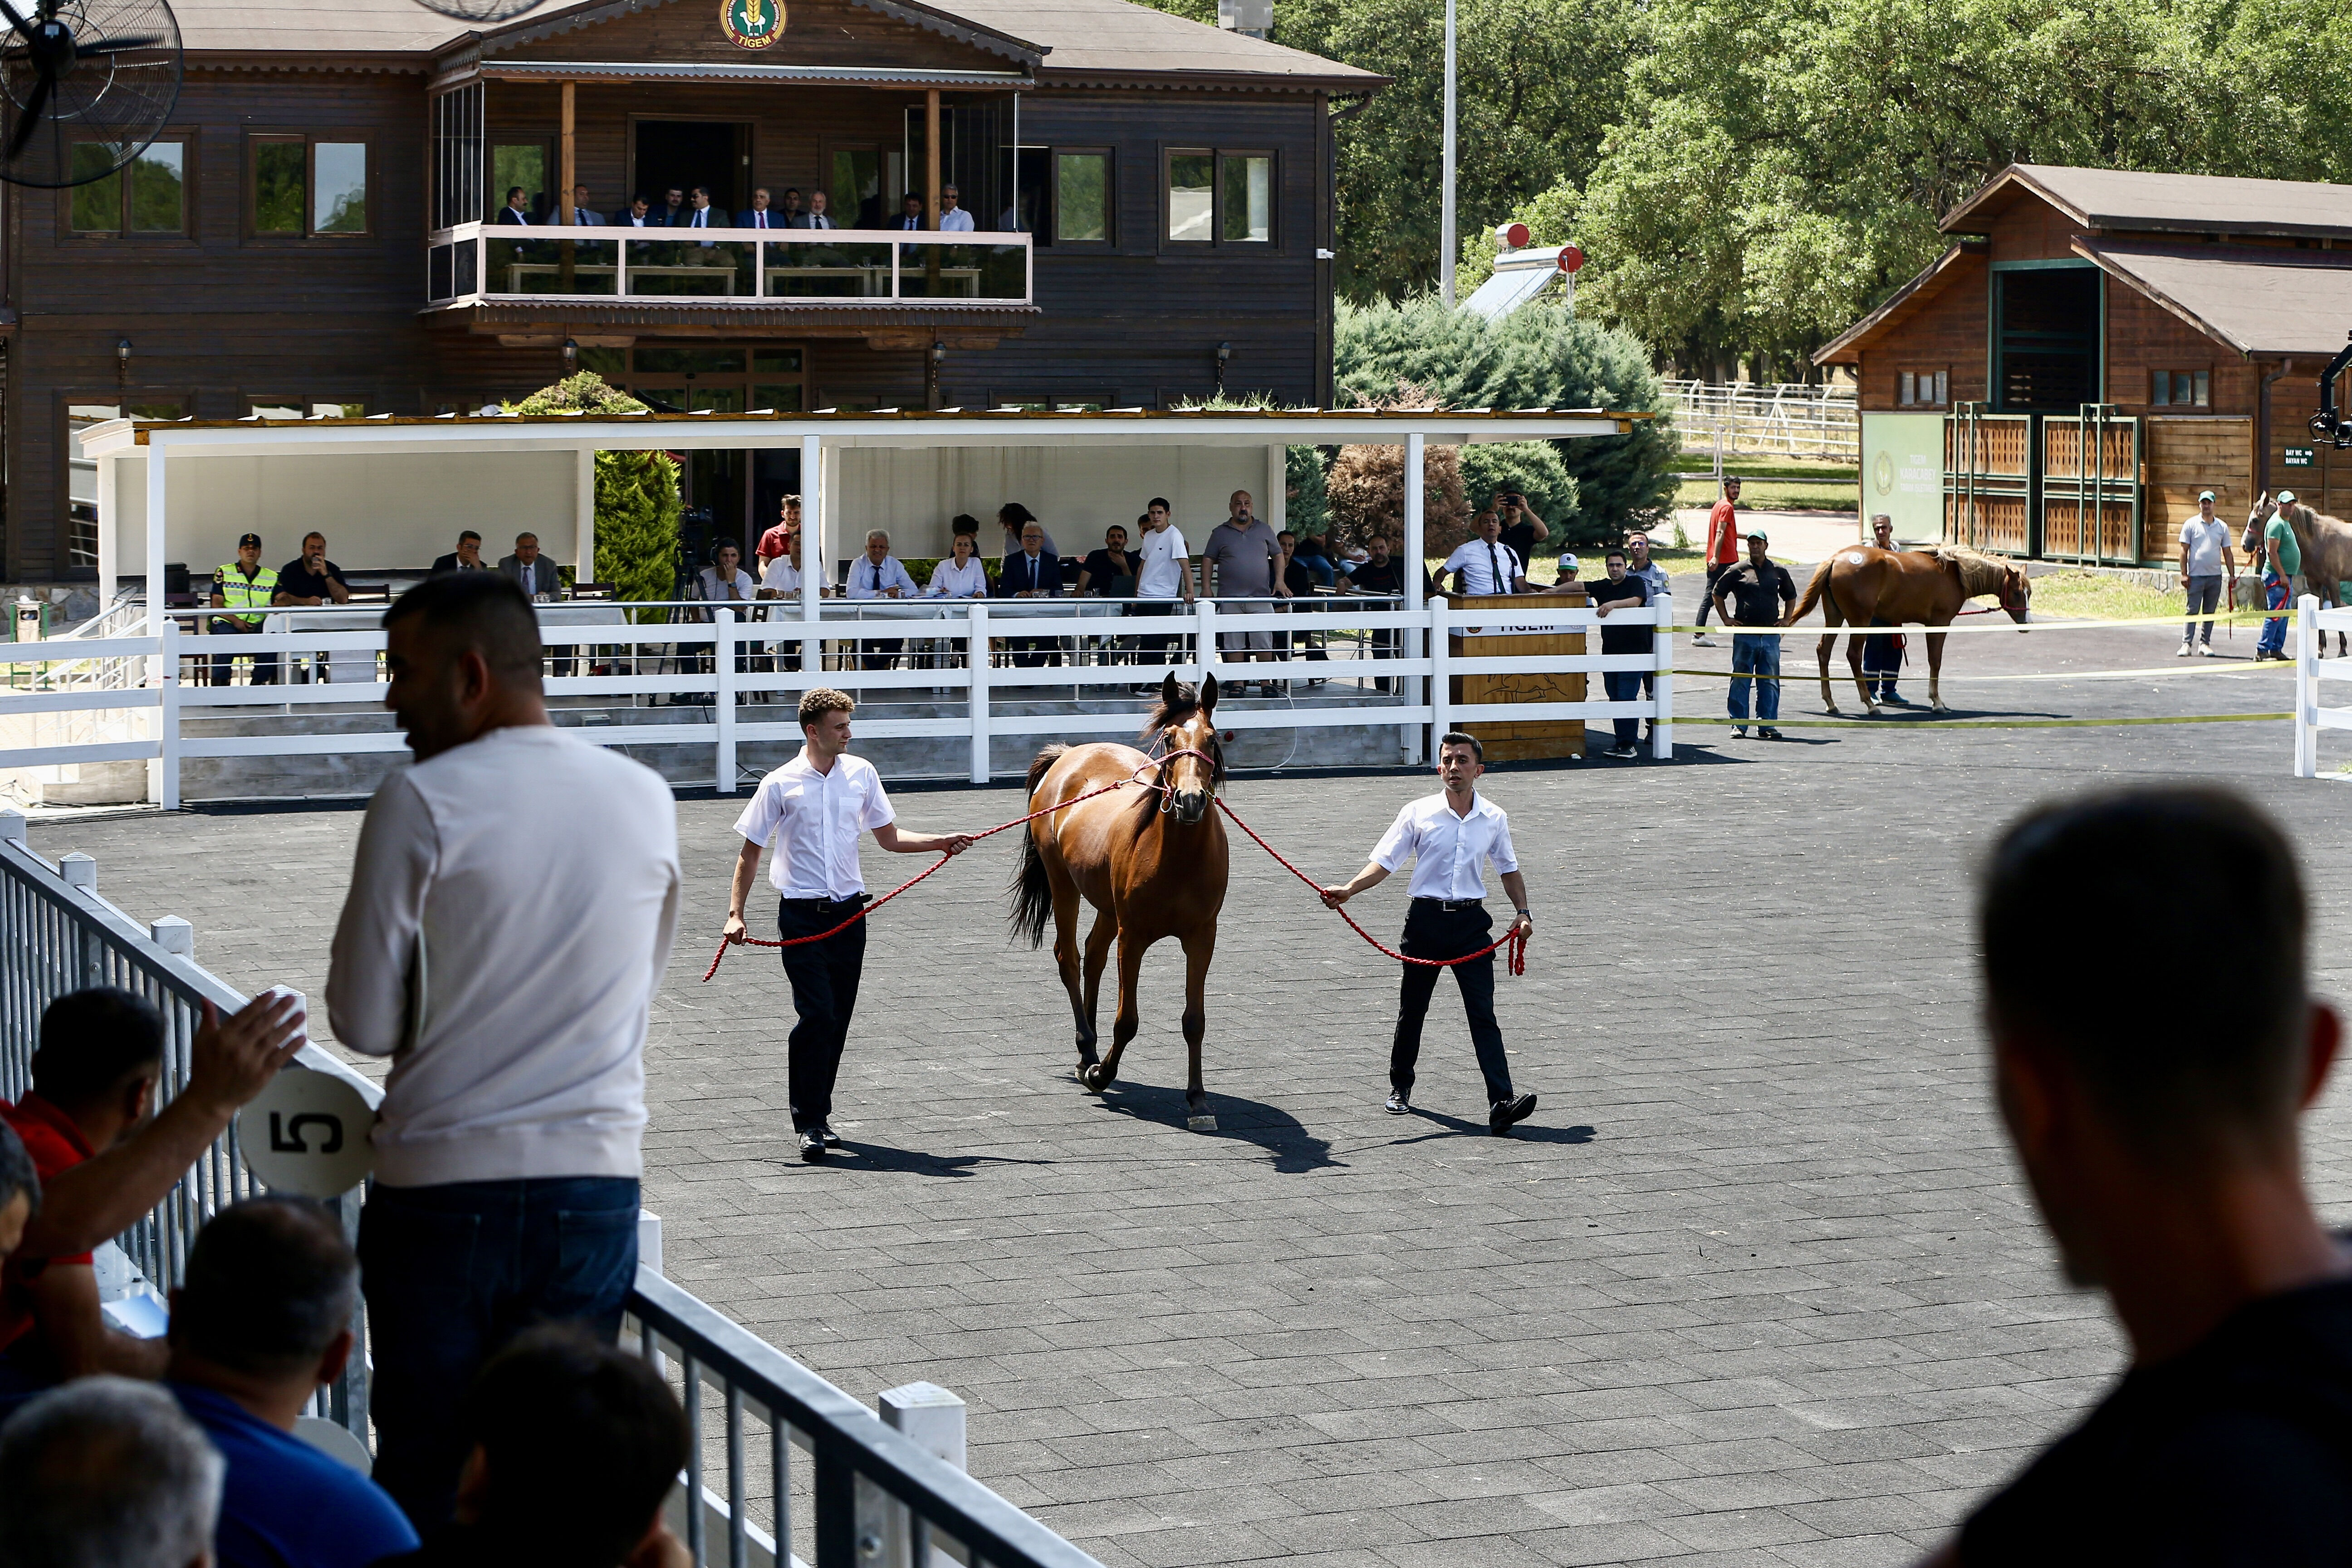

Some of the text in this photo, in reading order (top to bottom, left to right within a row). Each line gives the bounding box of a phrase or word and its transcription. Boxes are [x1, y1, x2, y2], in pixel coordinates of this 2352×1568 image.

[738, 35, 772, 48] TİGEM
[1900, 468, 1936, 480] KARACABEY
[270, 1112, 343, 1153] 5
